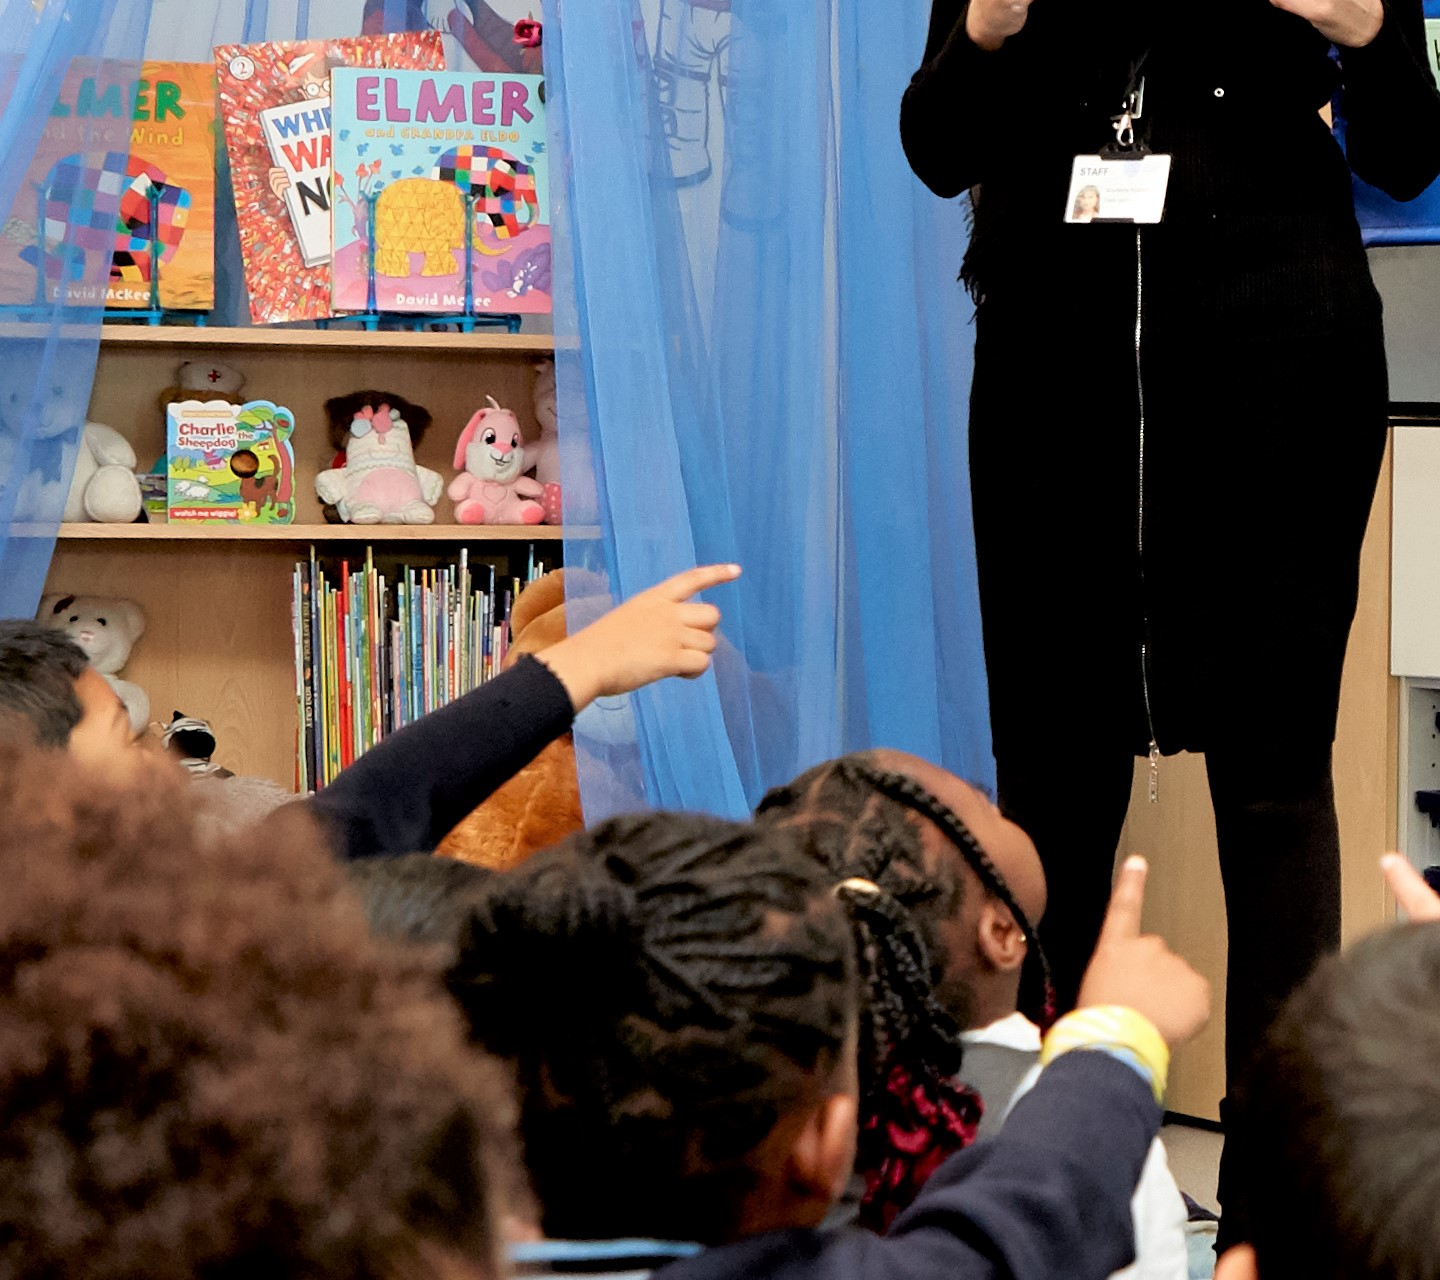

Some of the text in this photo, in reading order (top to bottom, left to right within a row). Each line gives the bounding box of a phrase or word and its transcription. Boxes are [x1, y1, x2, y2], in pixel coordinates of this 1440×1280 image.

[236, 61, 249, 74] 2
[355, 76, 535, 127] ELMER
[129, 126, 185, 147] Wind
[365, 127, 521, 143] and GRANDPA ELDO
[1080, 167, 1109, 176] STAFF
[396, 292, 492, 308] David Mcee
[179, 423, 254, 440] Charlie the
[178, 436, 236, 450] Sheepdog
